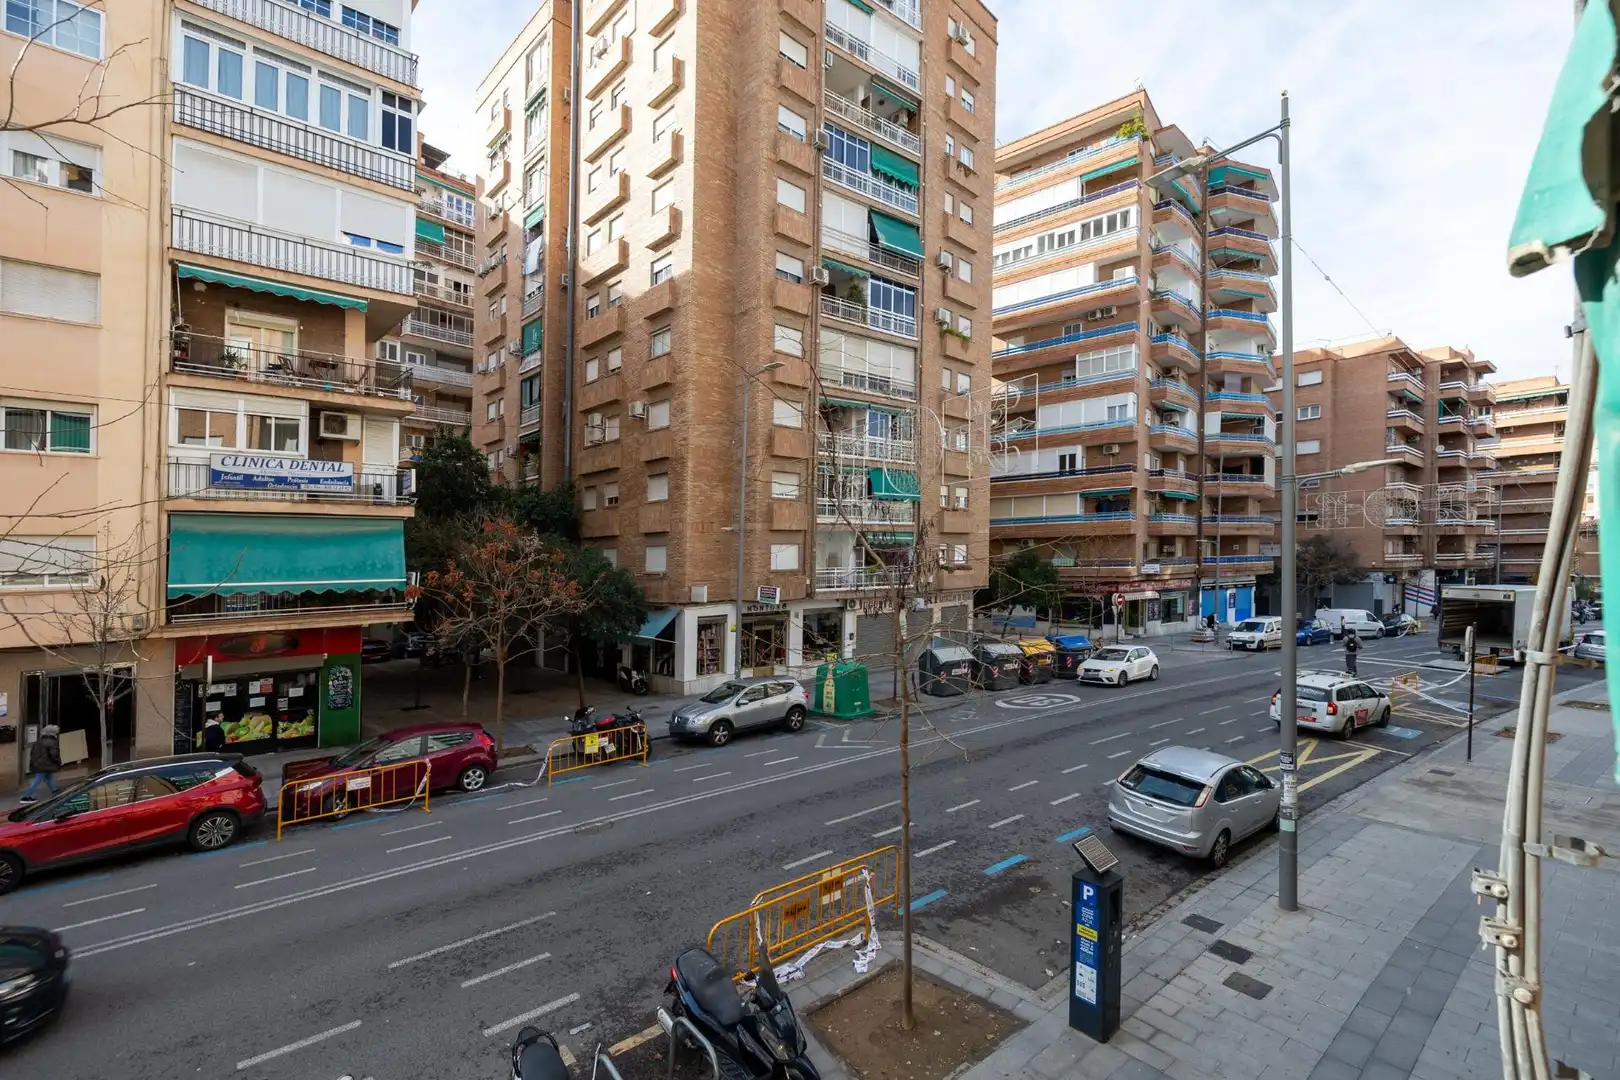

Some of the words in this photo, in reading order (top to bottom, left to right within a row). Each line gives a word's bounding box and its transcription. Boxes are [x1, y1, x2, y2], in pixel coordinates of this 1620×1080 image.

[221, 456, 284, 469] CLINICA
[289, 461, 345, 472] DENTAL
[1083, 885, 1094, 900] P
